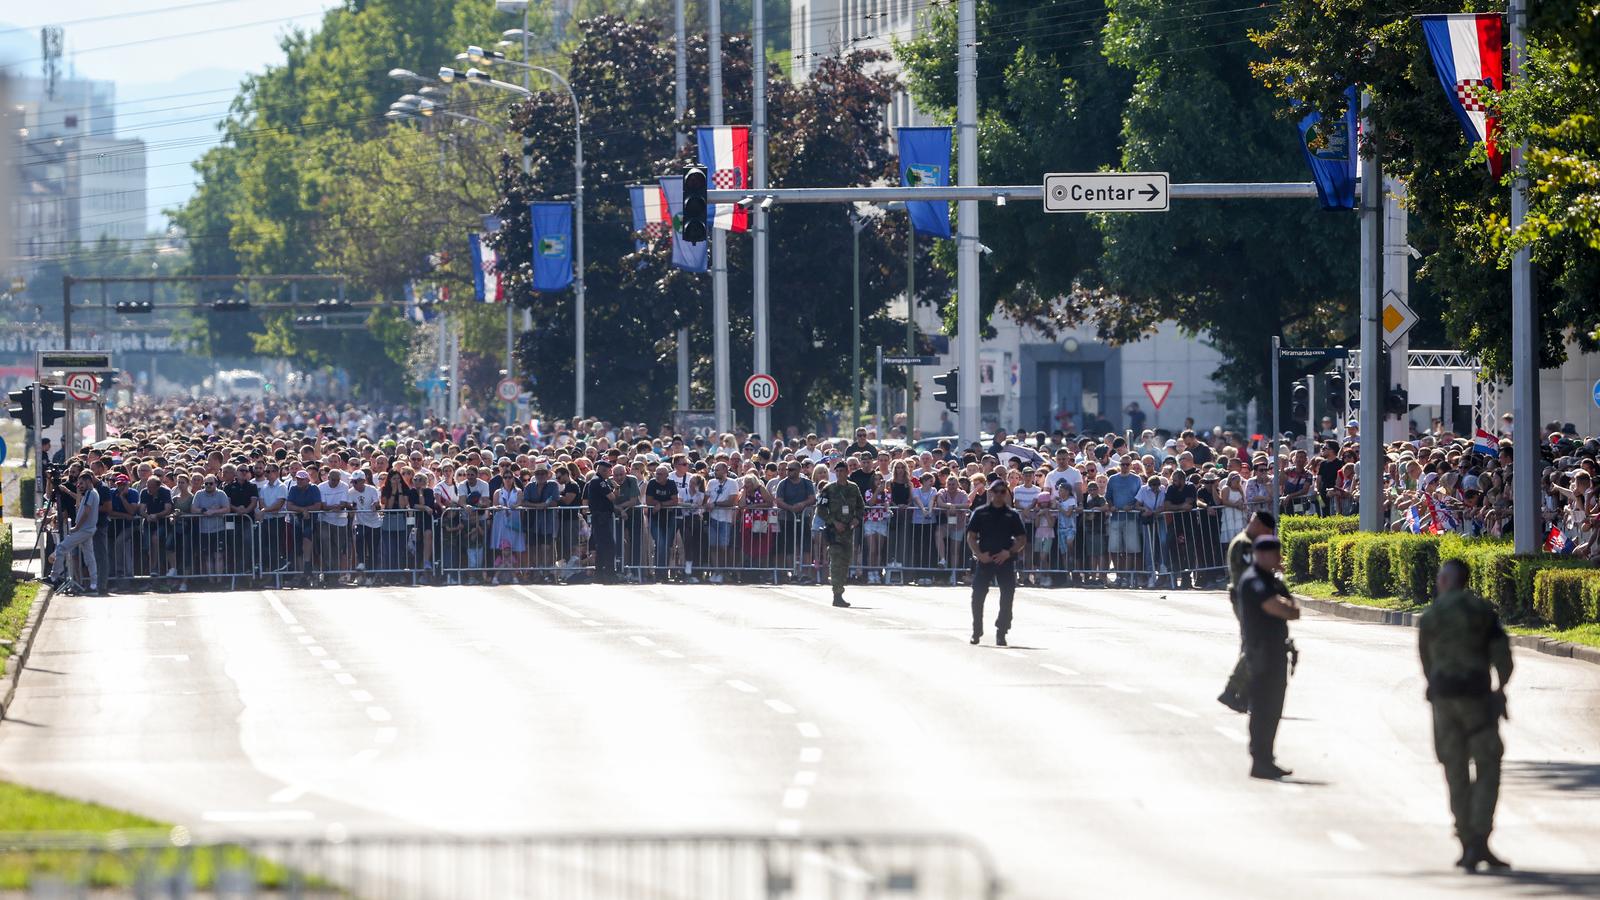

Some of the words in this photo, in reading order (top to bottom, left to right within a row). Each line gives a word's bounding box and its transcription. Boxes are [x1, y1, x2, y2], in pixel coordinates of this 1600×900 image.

[1071, 184, 1135, 201] Centar
[74, 378, 91, 394] 60
[752, 382, 771, 399] 60
